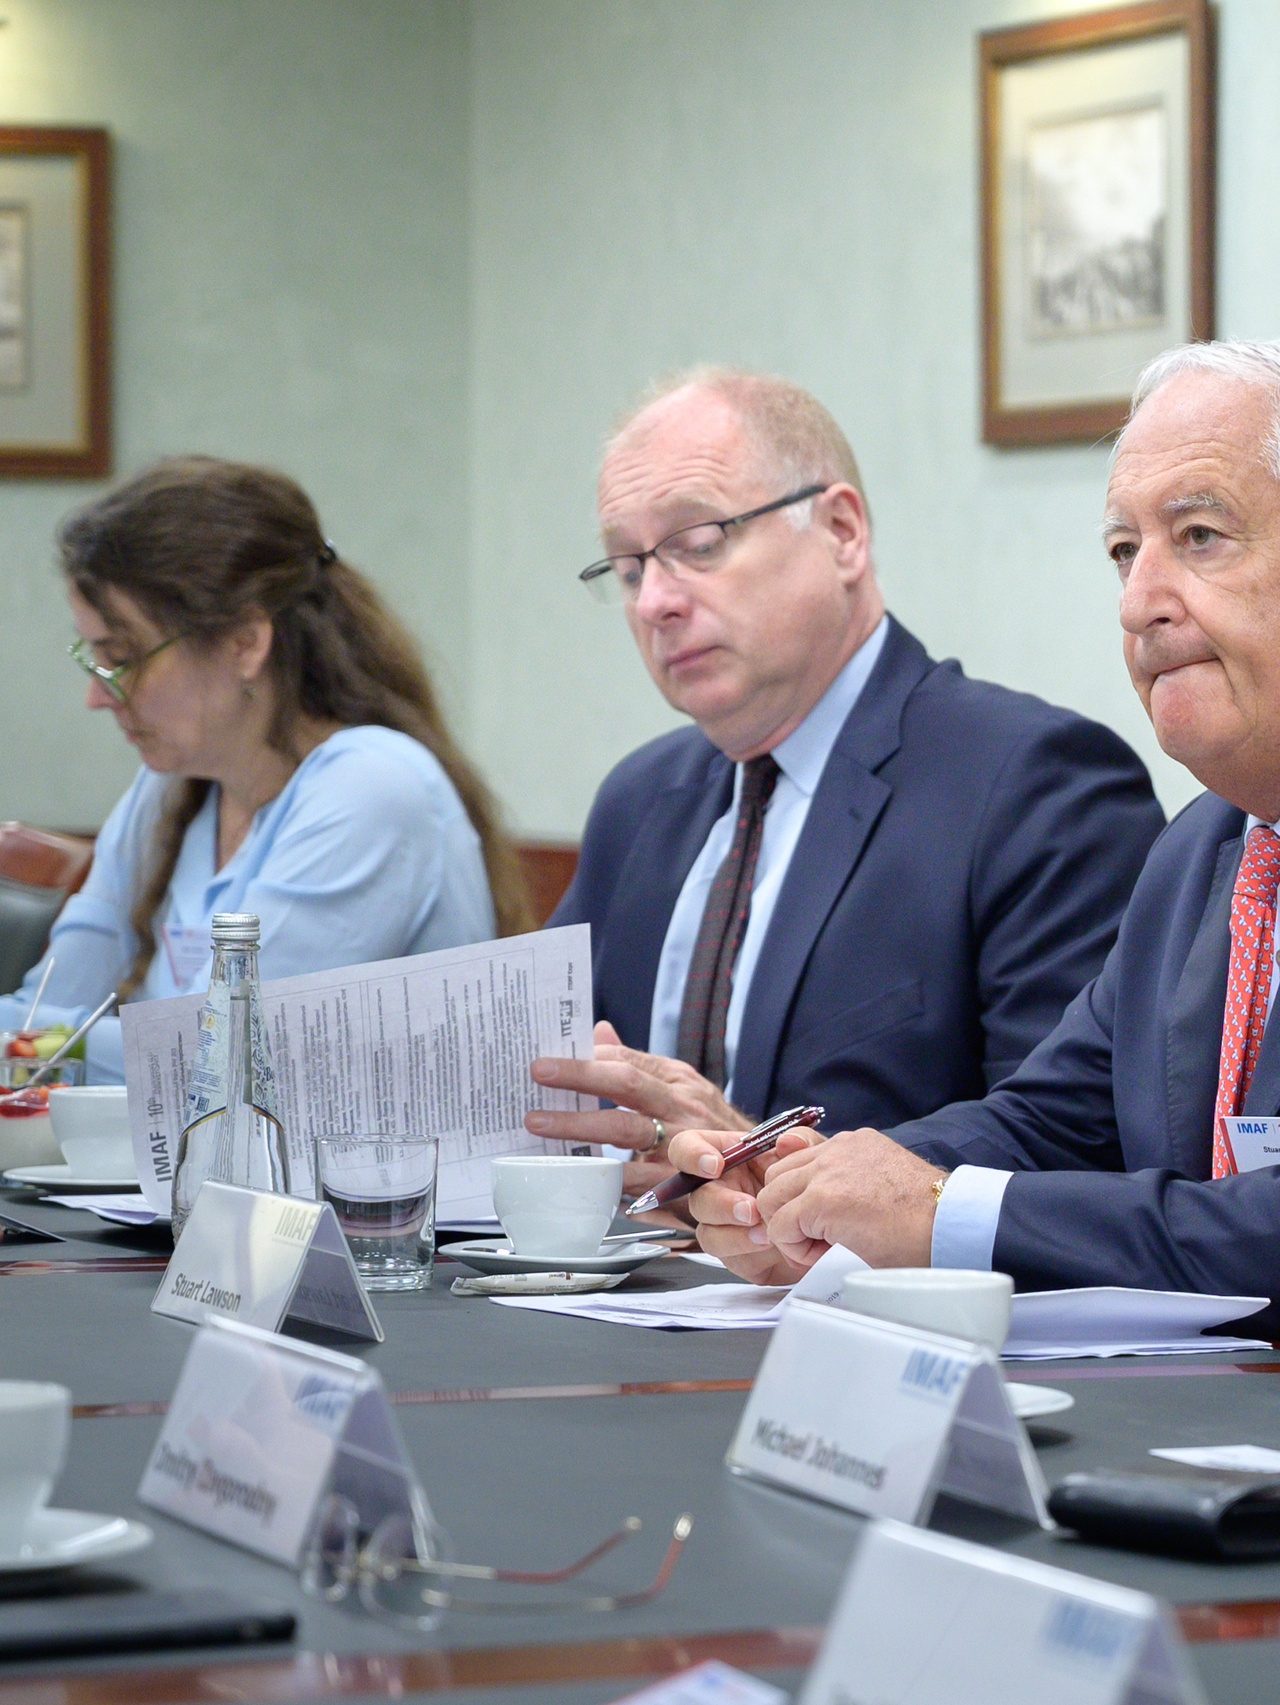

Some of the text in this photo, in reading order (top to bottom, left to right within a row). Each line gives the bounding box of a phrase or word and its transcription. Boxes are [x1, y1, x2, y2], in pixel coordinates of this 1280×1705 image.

[1237, 1123, 1268, 1134] IMAF
[149, 1131, 173, 1182] IMAF
[274, 1206, 317, 1241] IMAF
[171, 1273, 242, 1313] Stuart Lawson
[902, 1349, 968, 1395] IMAF
[752, 1417, 810, 1464] Michael
